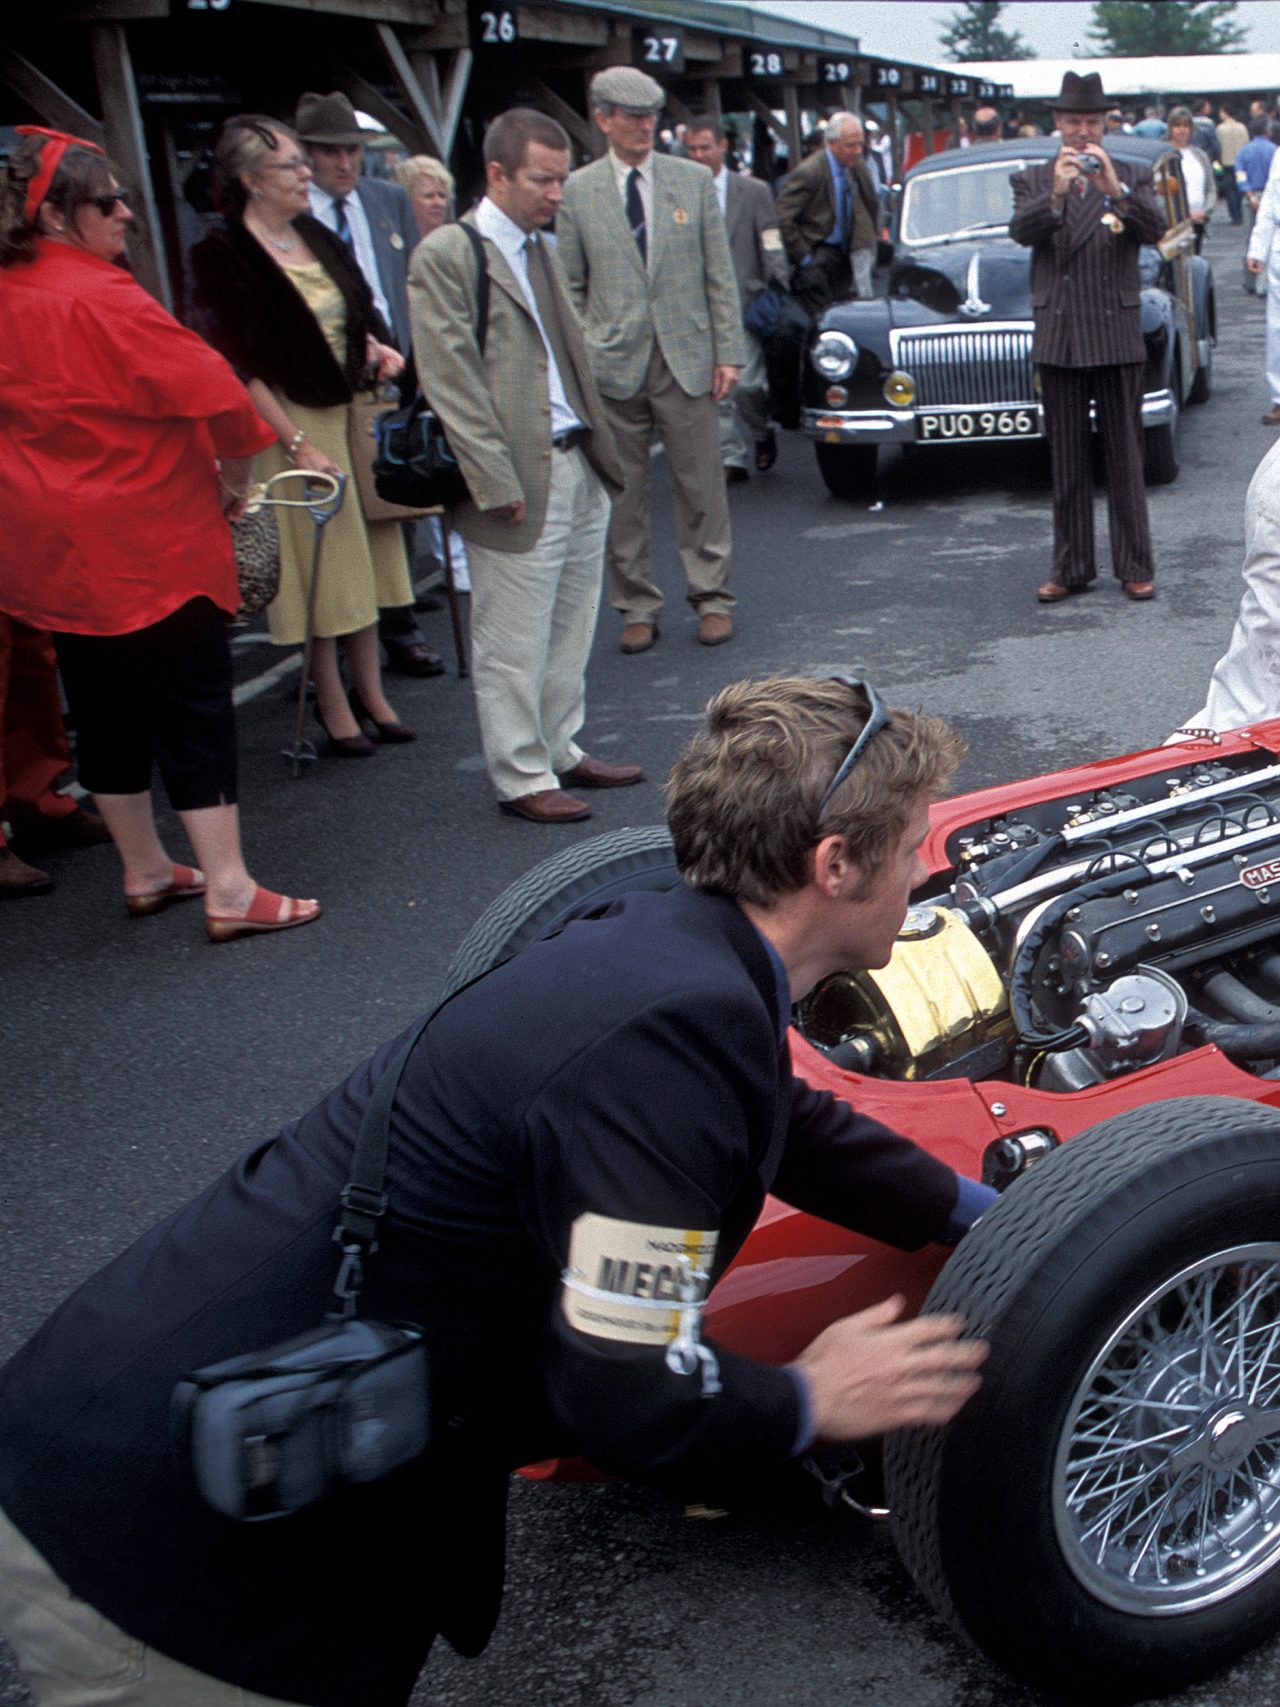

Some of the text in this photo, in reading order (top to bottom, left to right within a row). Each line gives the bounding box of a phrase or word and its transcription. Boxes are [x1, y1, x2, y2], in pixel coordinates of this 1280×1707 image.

[480, 11, 515, 43] 26
[643, 36, 678, 62] 27
[750, 52, 782, 76] 28
[824, 62, 849, 82] 29
[877, 68, 900, 86] 30
[922, 410, 1033, 438] PUO 966
